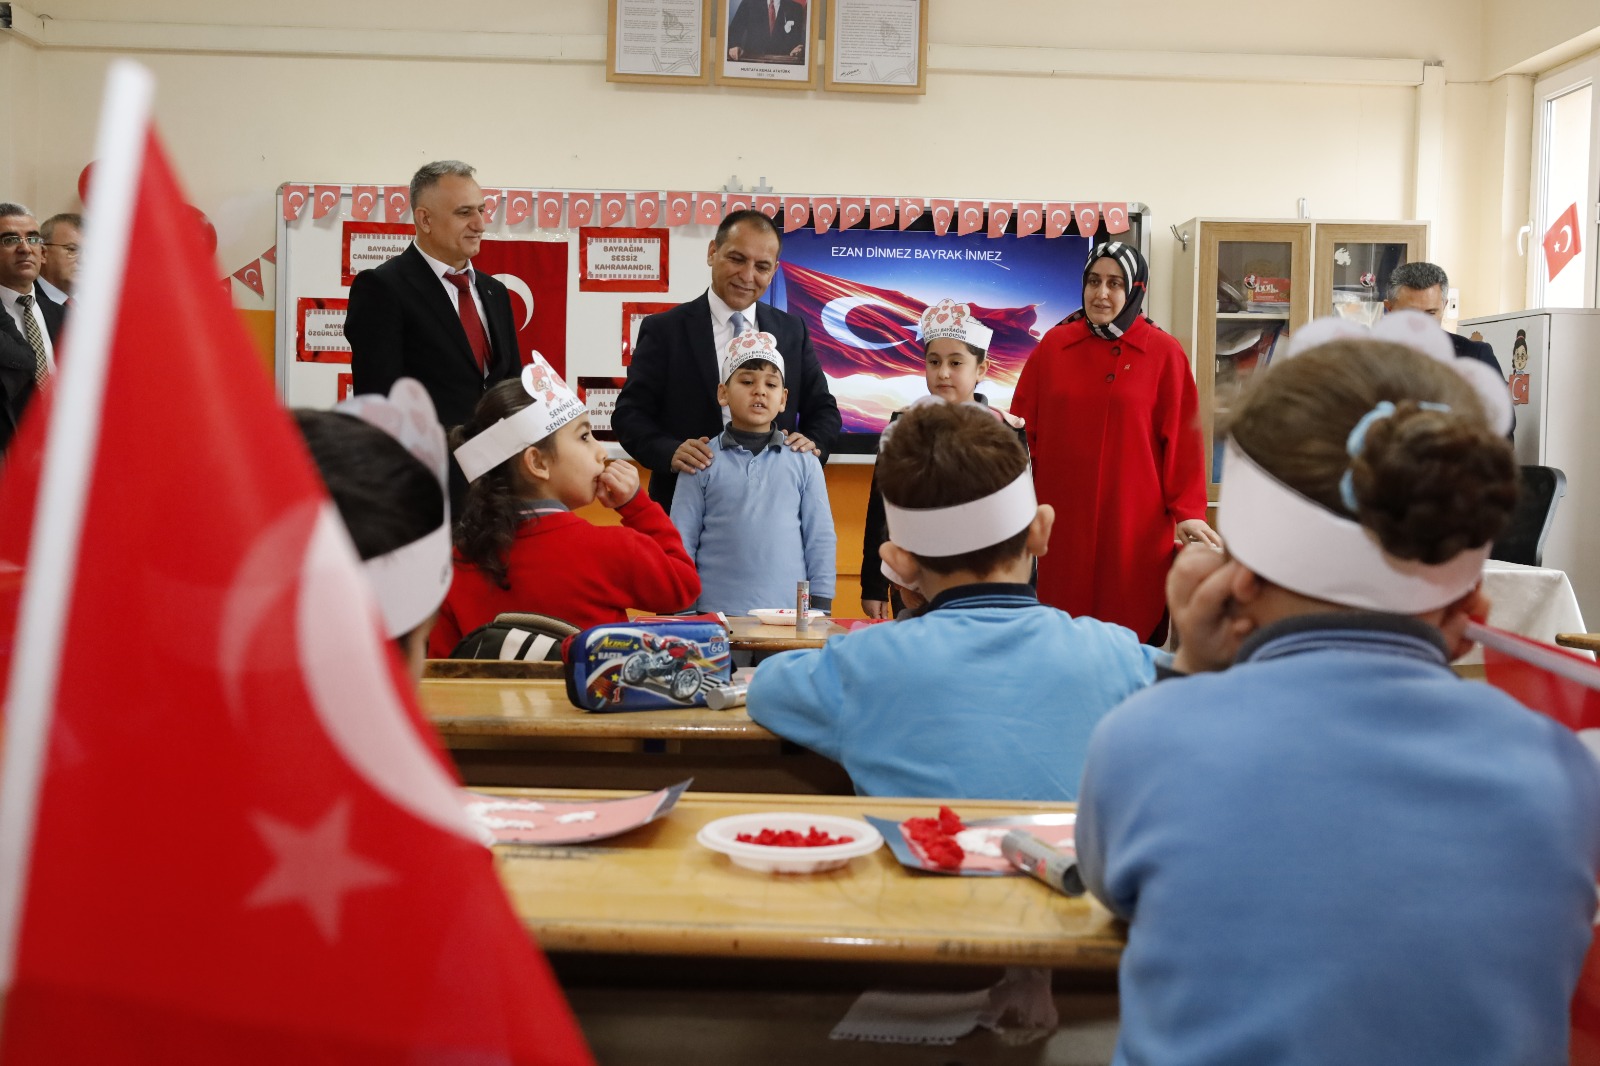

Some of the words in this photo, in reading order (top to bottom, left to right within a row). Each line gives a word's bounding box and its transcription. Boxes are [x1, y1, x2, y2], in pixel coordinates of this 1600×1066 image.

[603, 243, 646, 254] BAYRAĞIM,
[831, 246, 863, 257] EZAN
[866, 246, 912, 259] DİNMEZ
[914, 248, 963, 260] BAYRAK
[965, 248, 1002, 261] İNMEZ
[611, 254, 638, 262] SESSİZ
[594, 263, 654, 271] KAHRAMANDIR.
[590, 407, 603, 415] BİR
[545, 415, 567, 433] SENİN
[711, 643, 724, 653] 66
